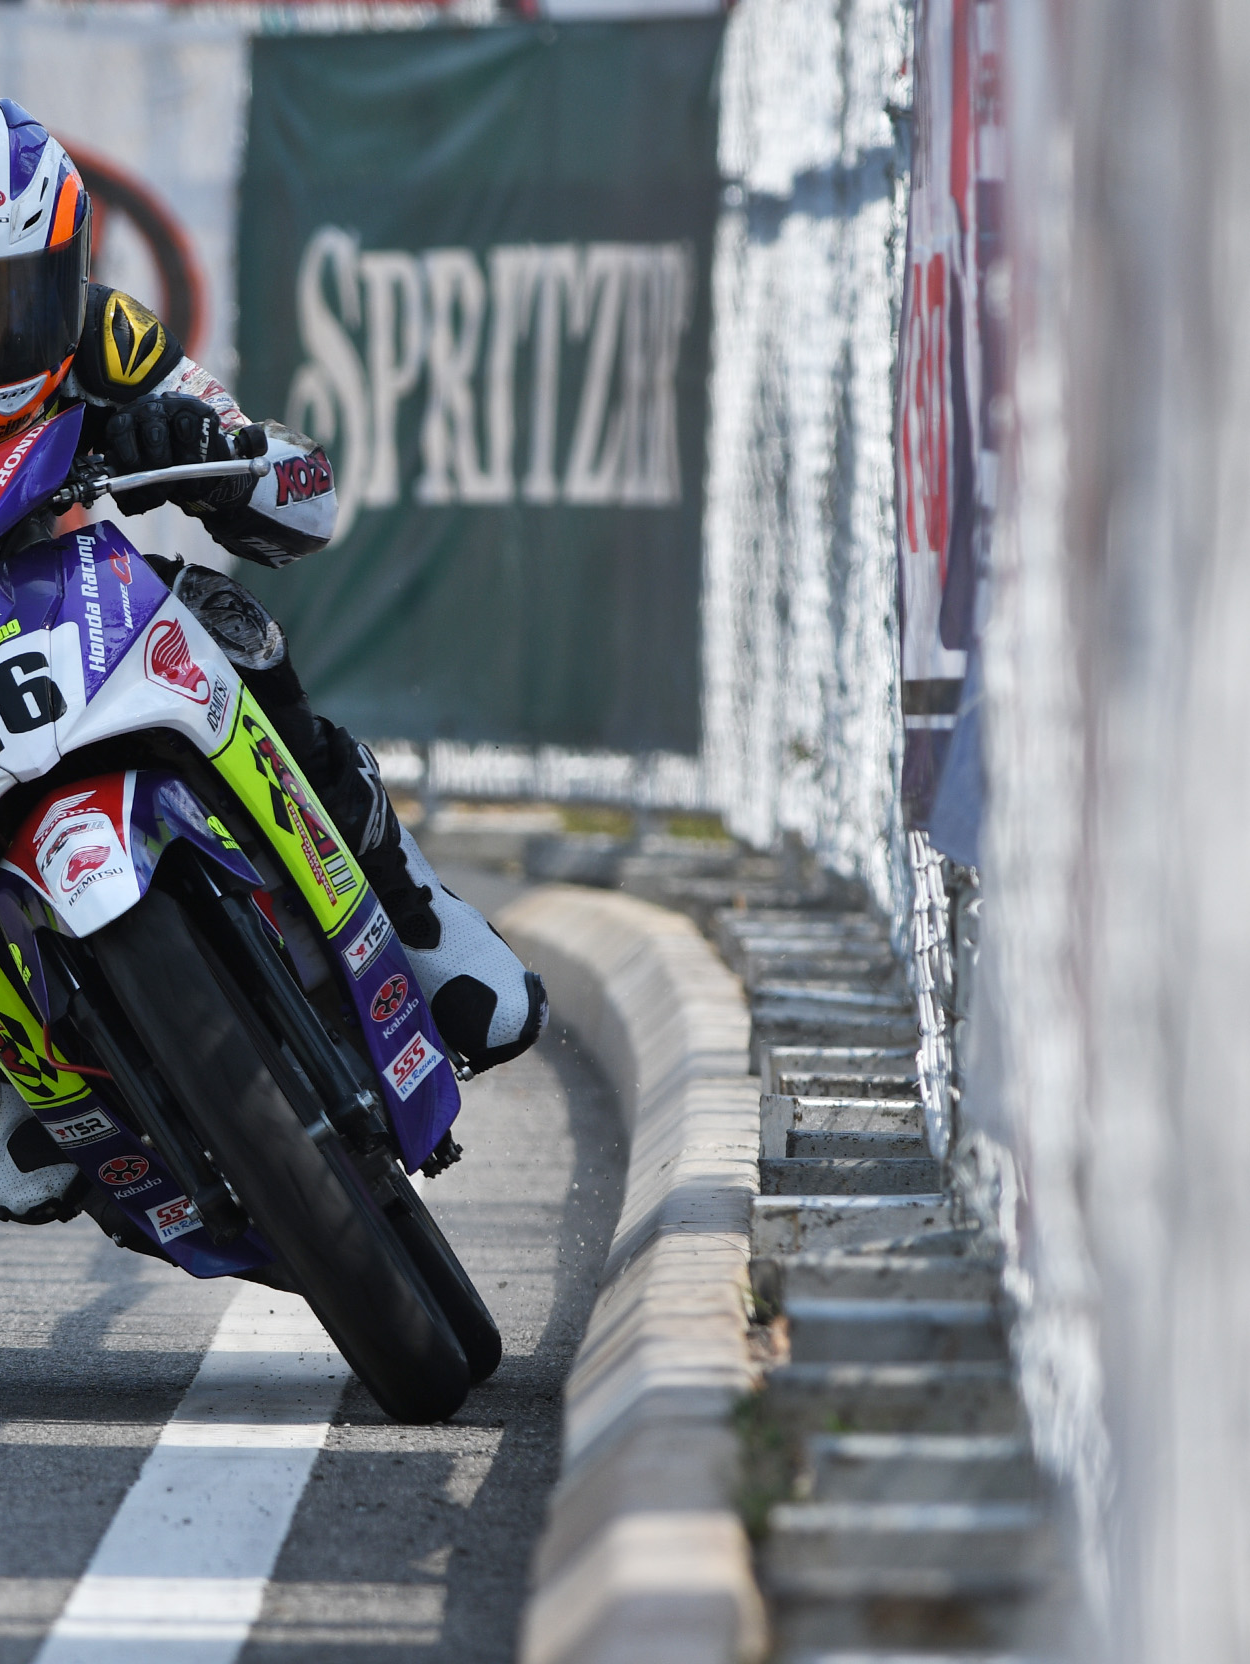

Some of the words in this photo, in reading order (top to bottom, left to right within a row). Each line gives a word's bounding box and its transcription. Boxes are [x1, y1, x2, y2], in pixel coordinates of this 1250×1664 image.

[76, 534, 99, 598] Racing
[85, 602, 106, 672] Honda
[207, 674, 228, 733] IDEMITSU
[288, 804, 336, 904] PERFORMANCE
[302, 846, 322, 885] PARTS
[68, 867, 124, 907] IDEMITSU
[363, 913, 387, 949] TSR
[382, 998, 420, 1039] Kabuto
[393, 1036, 426, 1087] SSS
[411, 1054, 437, 1081] Racing
[64, 1117, 104, 1138] TSR
[113, 1177, 163, 1200] Kabuto
